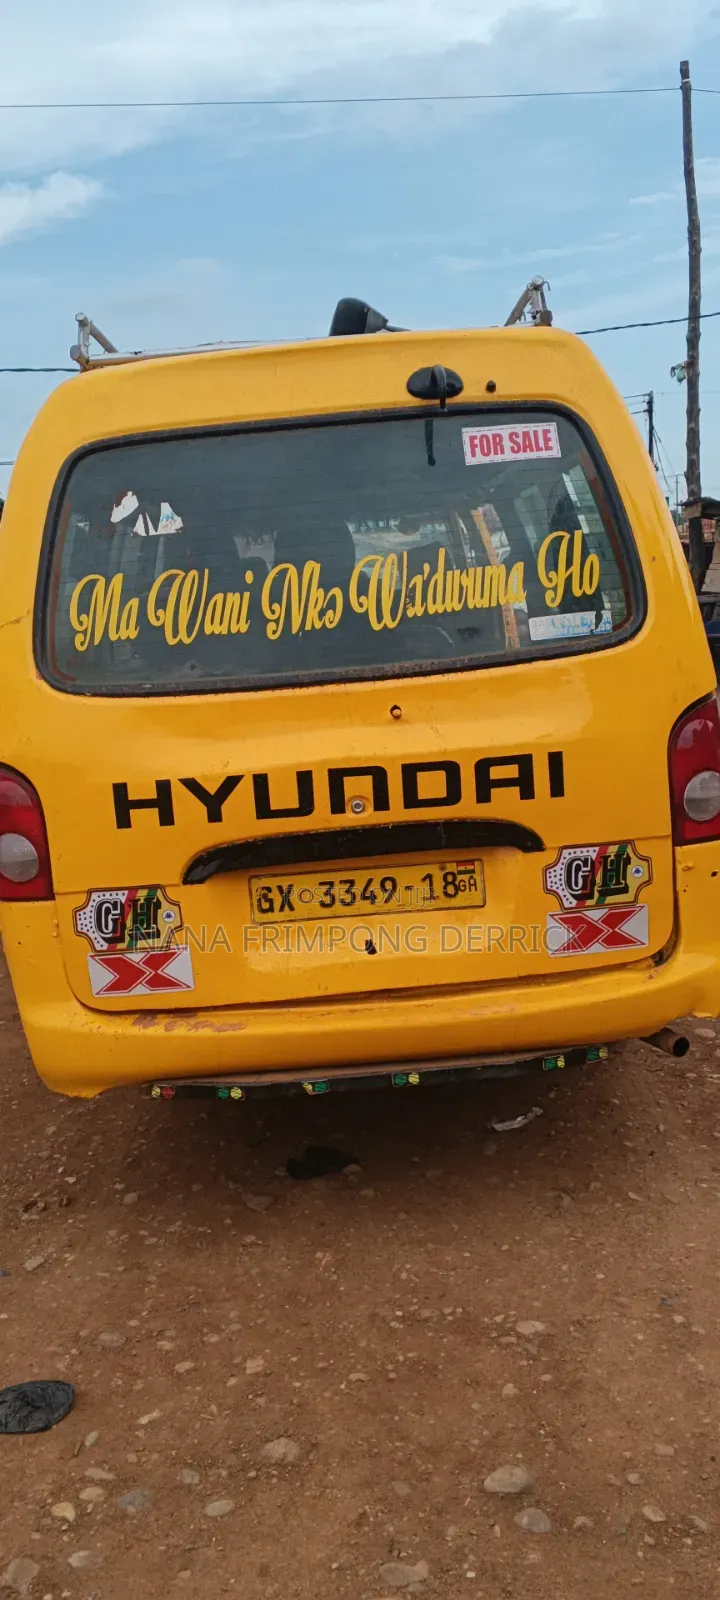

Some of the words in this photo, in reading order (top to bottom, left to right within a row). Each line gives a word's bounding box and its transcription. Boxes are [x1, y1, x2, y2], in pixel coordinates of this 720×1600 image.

[469, 433, 505, 458] FOR
[508, 429, 553, 454] SALE
[70, 573, 140, 651] Ma
[147, 568, 254, 645] Wani
[537, 529, 600, 608] Ho
[112, 751, 565, 829] HYUNDAI
[256, 884, 295, 913] GX
[564, 853, 631, 901] GH
[95, 895, 162, 944] GH
